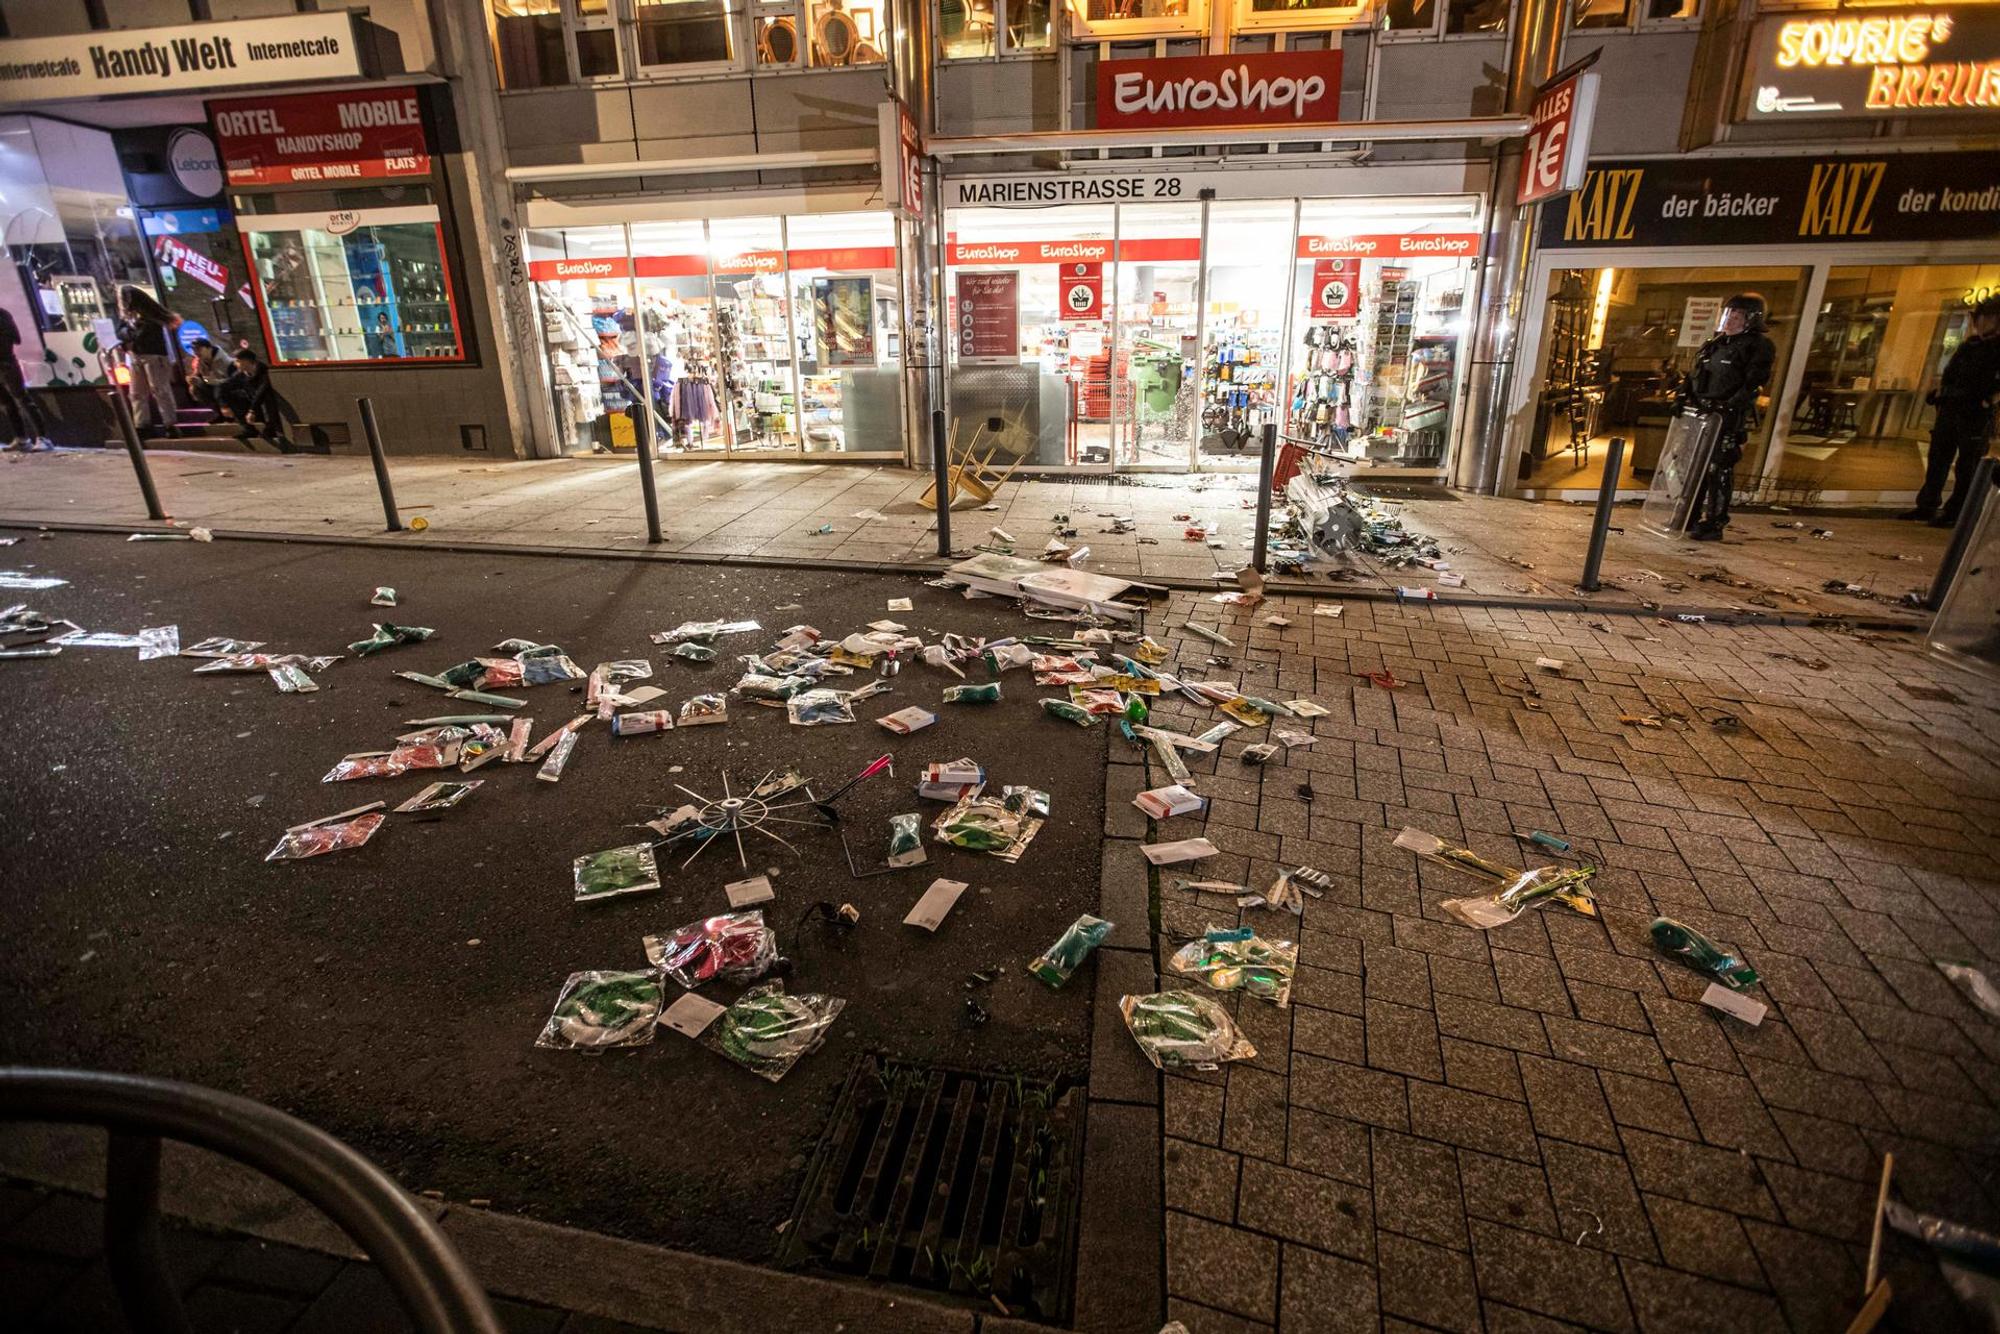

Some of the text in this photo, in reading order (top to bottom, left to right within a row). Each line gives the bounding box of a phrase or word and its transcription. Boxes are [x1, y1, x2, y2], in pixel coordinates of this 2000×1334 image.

[89, 42, 171, 78] Handy
[170, 36, 237, 72] Welt
[247, 36, 339, 61] Internetcafe
[1114, 64, 1326, 118] EuroShop
[216, 99, 420, 137] ORTEL MOBILE
[1534, 88, 1571, 125] ALLES
[276, 133, 363, 154] HANDYSHOP
[385, 157, 416, 170] FLATS
[1525, 121, 1566, 196] 1€
[291, 165, 361, 180] ORTEL MOBILE
[959, 178, 1181, 203] MARIENSTRASSE 28
[1564, 162, 2000, 241] KATZ der bäcker KATZ der kondi
[956, 243, 1106, 261] EuroShop EuroShop
[1308, 236, 1470, 256] EuroShop EuroShop
[556, 262, 612, 276] EuroShop
